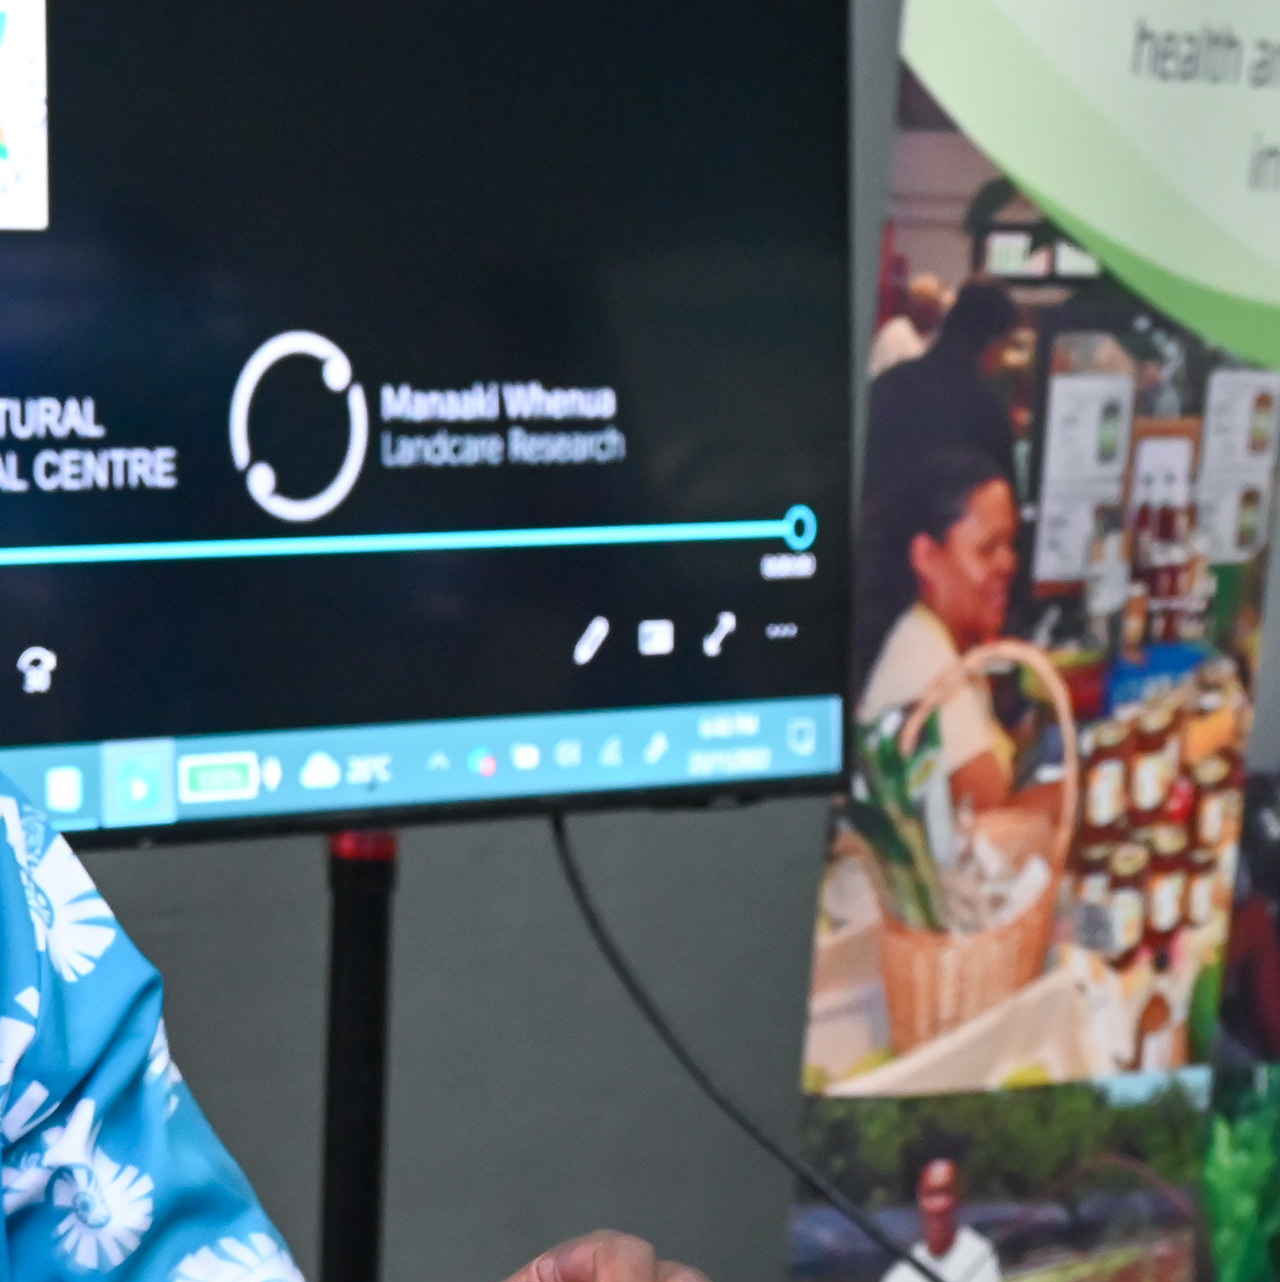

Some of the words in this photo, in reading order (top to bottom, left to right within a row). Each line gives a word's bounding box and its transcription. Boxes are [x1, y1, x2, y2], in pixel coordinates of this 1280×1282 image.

[1131, 19, 1245, 86] health
[380, 381, 499, 422] Manaaki
[502, 380, 617, 420] Whenua
[32, 445, 179, 491] CENTRE
[380, 428, 504, 468] Landcare
[507, 425, 627, 465] Research
